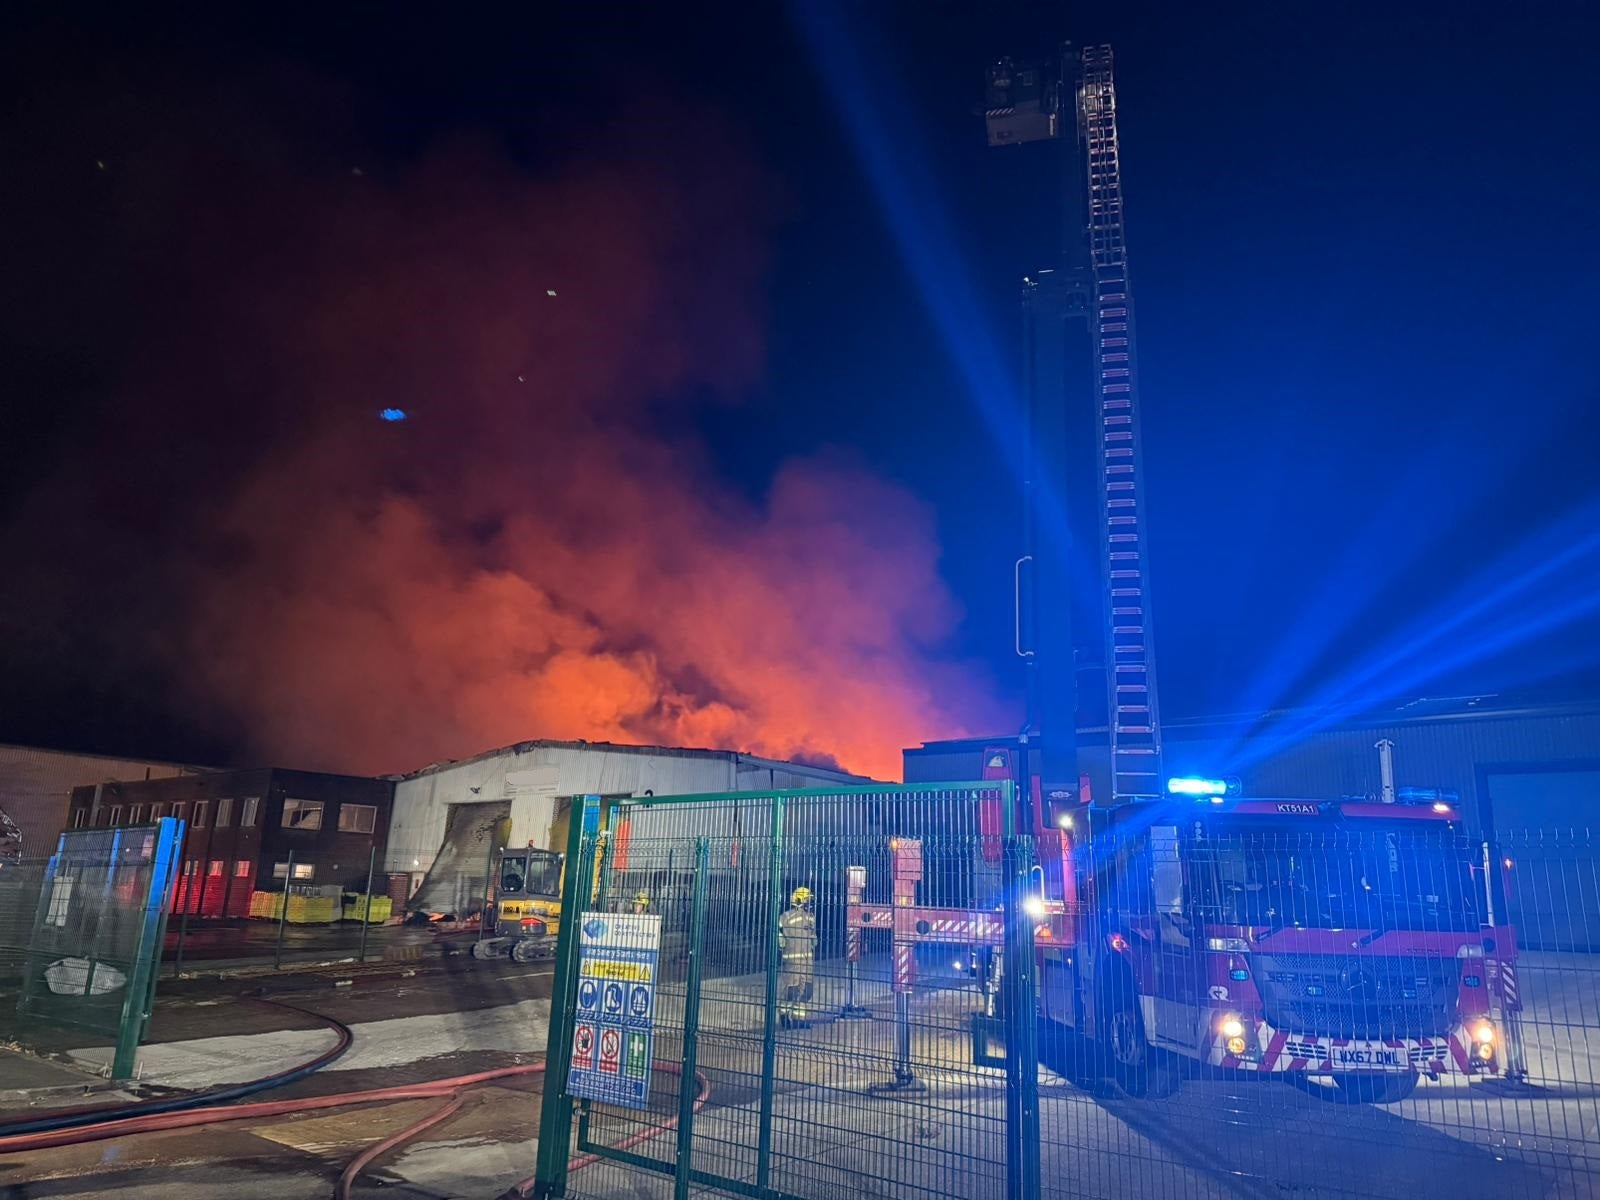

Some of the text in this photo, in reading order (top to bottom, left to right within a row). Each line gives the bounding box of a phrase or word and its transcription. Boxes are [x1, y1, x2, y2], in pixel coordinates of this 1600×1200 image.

[1277, 803, 1314, 813] KT51A1
[614, 930, 656, 938] CONTCTON
[1340, 1050, 1372, 1064] WX67
